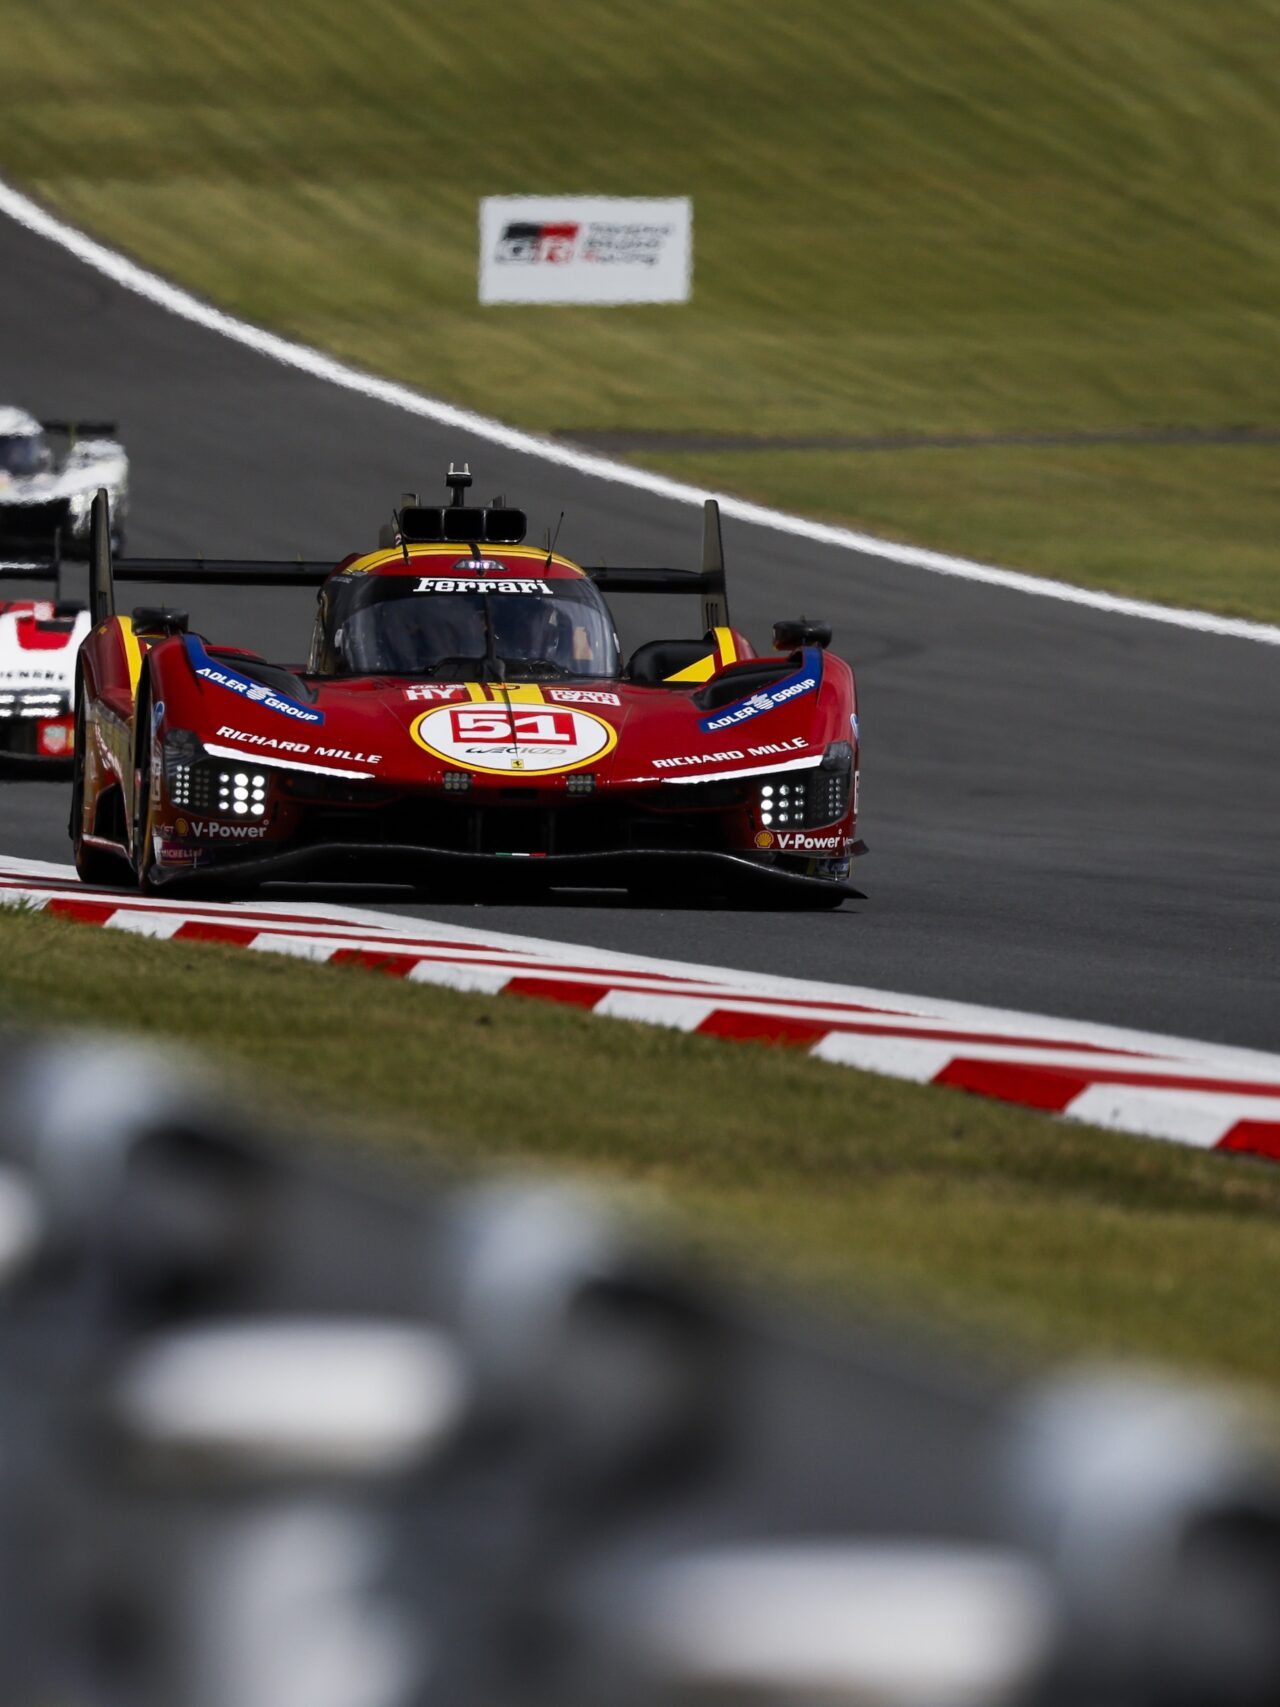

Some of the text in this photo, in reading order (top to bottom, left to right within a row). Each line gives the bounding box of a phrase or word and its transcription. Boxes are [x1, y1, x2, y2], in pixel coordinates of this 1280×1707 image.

[413, 577, 554, 595] Ferrari
[196, 668, 319, 721] ADLER GROUP
[706, 678, 816, 730] ADLER GROUP
[457, 713, 570, 741] 51
[216, 726, 382, 764] RICHARD MILLE
[651, 736, 809, 768] RICHARD MILLE
[191, 822, 267, 838] V-Power
[776, 833, 841, 849] V-Power
